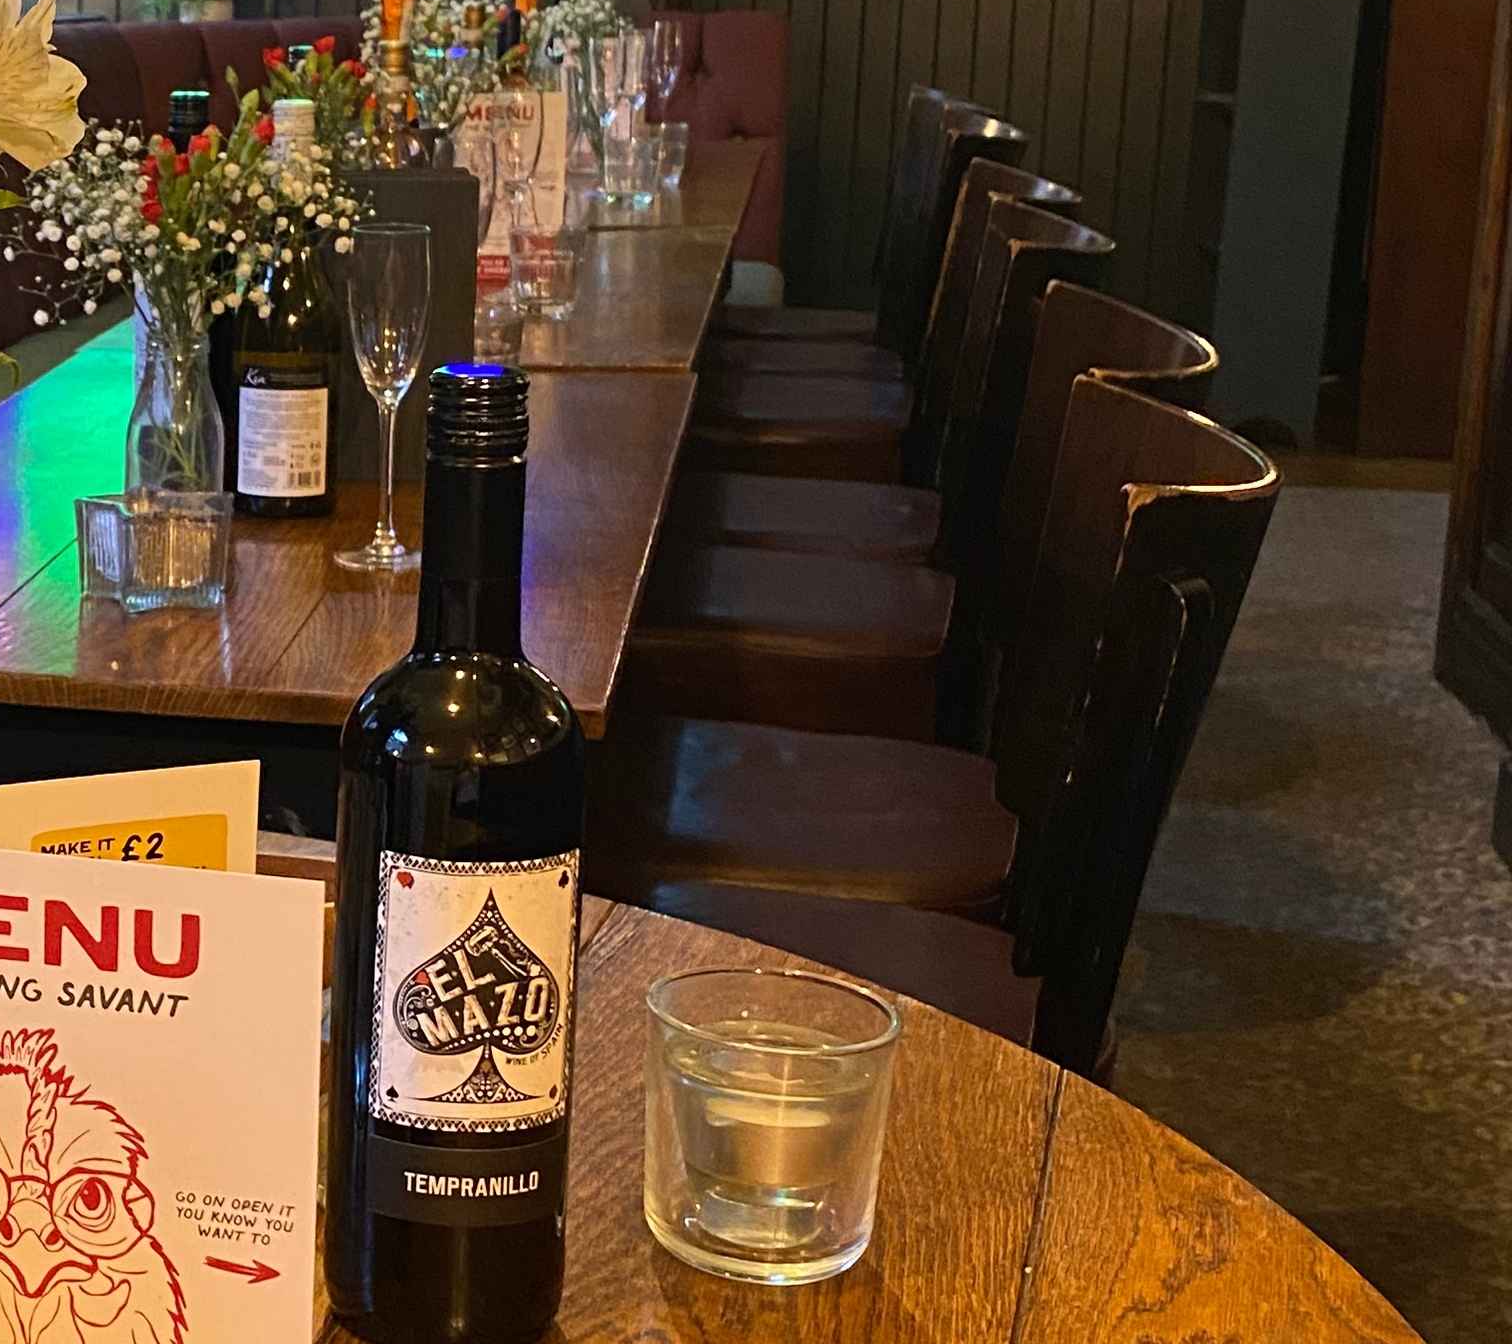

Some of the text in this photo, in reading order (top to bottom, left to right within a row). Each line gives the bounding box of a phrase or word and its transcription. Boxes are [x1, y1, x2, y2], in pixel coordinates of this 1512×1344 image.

[40, 832, 164, 862] MAKE IT £2
[425, 948, 496, 1003] EL
[57, 981, 189, 1017] SAVANT
[416, 976, 549, 1047] MAZO
[540, 1023, 564, 1059] SPAIN
[403, 1170, 539, 1198] TEMPRANILLO
[175, 1191, 295, 1217] GO ON OPEN IT
[176, 1206, 294, 1233] YOU KNOW YOU
[197, 1224, 271, 1246] WANT TO
